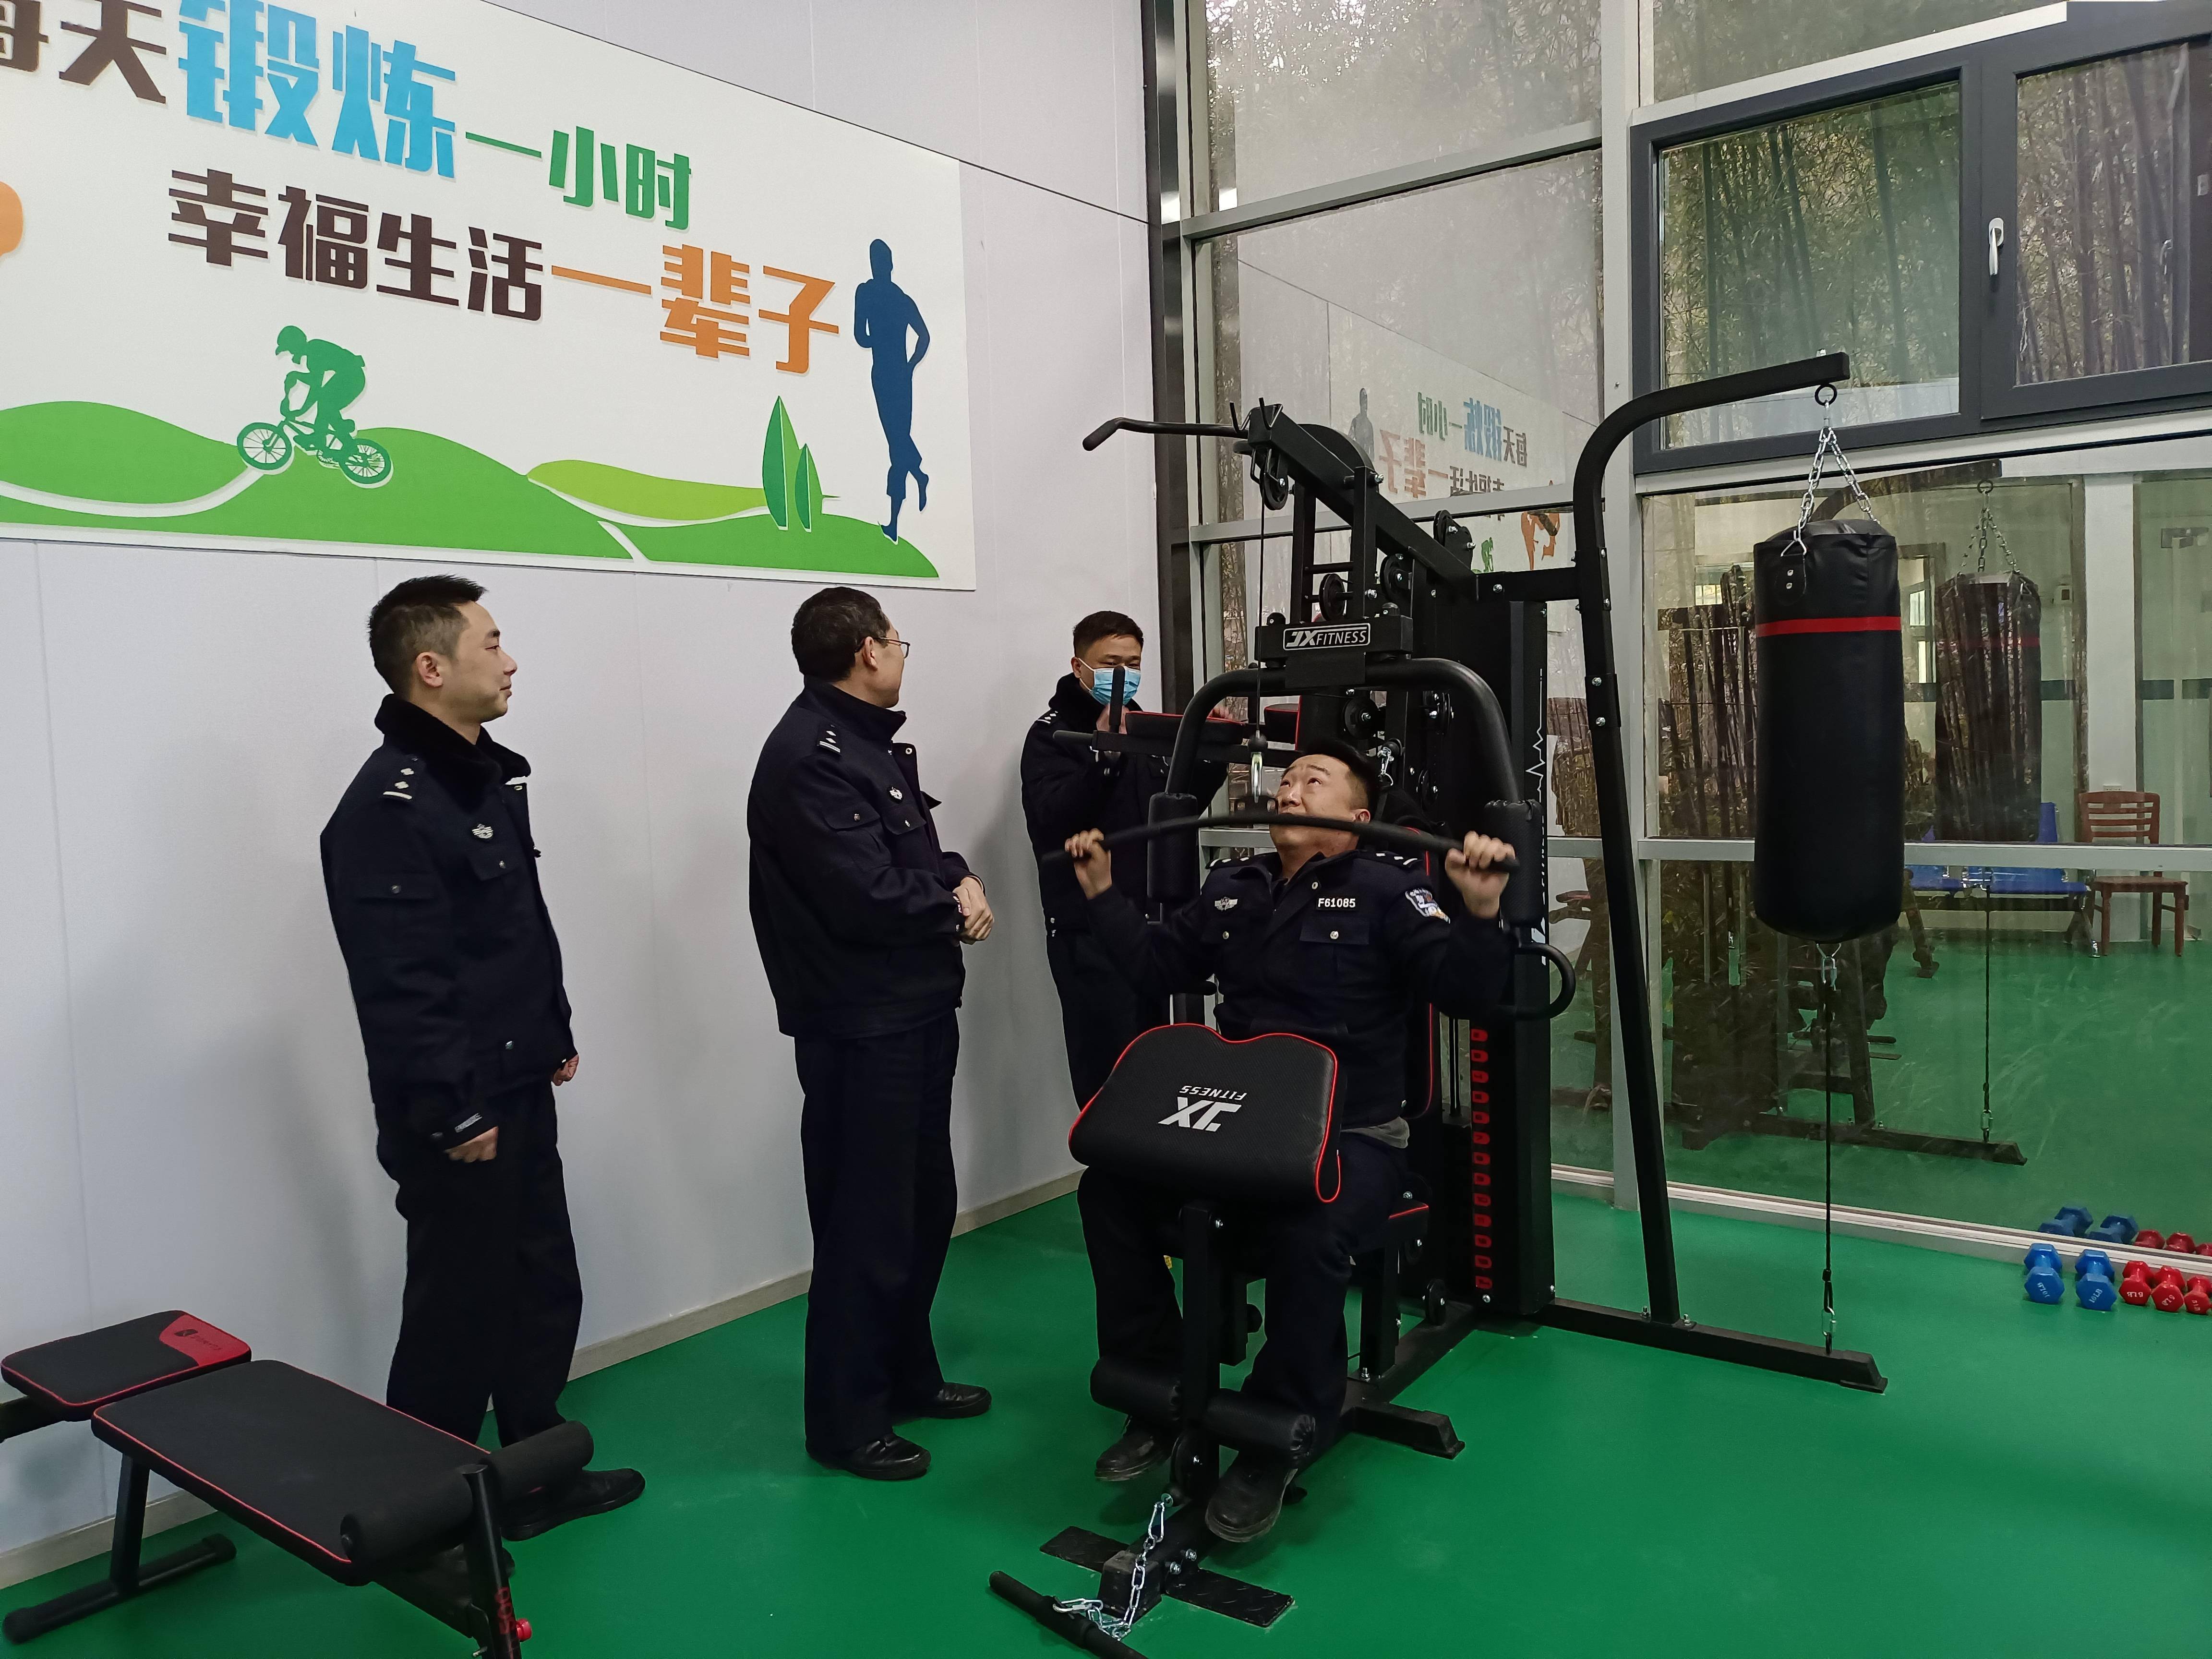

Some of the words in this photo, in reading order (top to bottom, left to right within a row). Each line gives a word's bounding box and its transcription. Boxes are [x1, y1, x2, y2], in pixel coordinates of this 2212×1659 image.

[168, 168, 839, 373] 幸福生活一辈子
[1318, 898, 1356, 908] F61085
[1179, 1085, 1247, 1100] FITNESS
[1157, 1096, 1242, 1132] JX
[2089, 1288, 2104, 1303] 10LB
